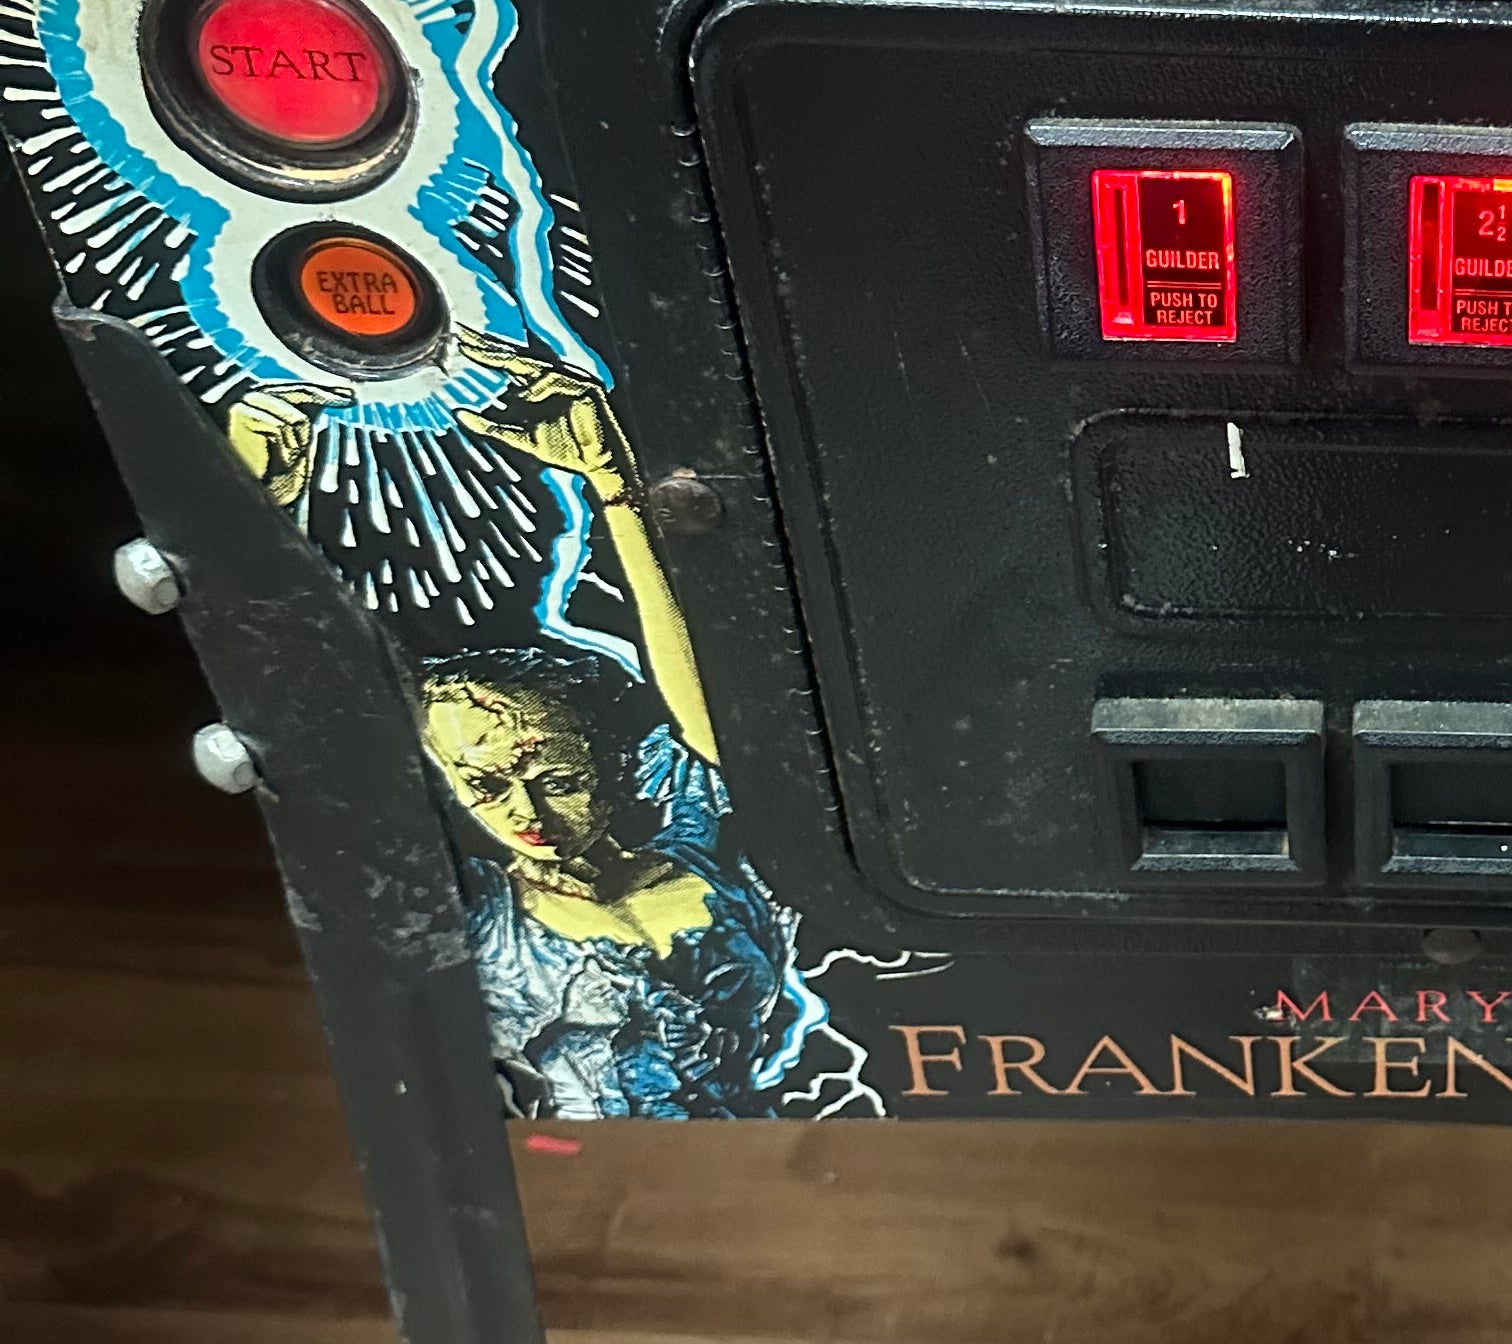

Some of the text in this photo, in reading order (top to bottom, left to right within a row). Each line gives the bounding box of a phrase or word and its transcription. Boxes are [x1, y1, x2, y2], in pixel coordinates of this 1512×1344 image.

[210, 44, 369, 84] START
[1172, 199, 1187, 225] 1
[1145, 249, 1221, 270] GUILDER
[315, 269, 400, 295] EXTRA
[333, 293, 397, 317] BALL
[1150, 291, 1218, 308] PUSH TO
[1456, 300, 1498, 316] PUSH
[1156, 309, 1213, 325] REJECT
[1273, 989, 1512, 1024] MARY
